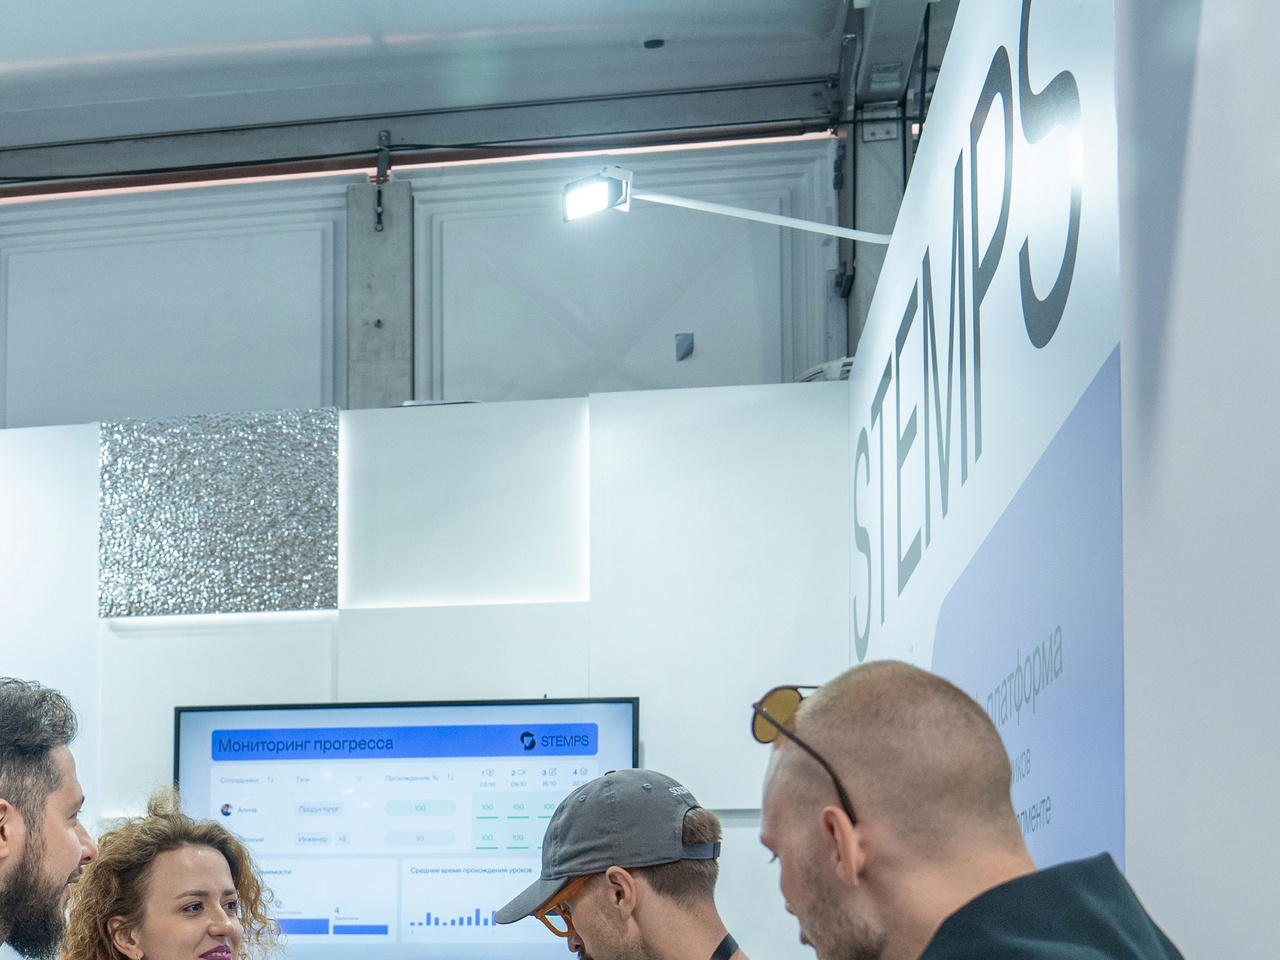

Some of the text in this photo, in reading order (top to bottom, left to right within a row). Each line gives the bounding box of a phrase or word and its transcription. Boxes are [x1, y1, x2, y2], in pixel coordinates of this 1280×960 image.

[853, 0, 1082, 662] STEMPS
[986, 624, 1063, 728] платформа
[540, 734, 590, 747] STEMPS
[219, 737, 394, 754] Мониторинг прогресса
[414, 804, 427, 812] 100
[481, 803, 494, 811] 100
[512, 803, 525, 811] 100
[543, 803, 555, 811] 100
[481, 834, 493, 842] 100
[512, 833, 524, 841] 100
[410, 867, 439, 875] Среднее
[462, 867, 508, 875] прохождения
[508, 867, 532, 875] уроков
